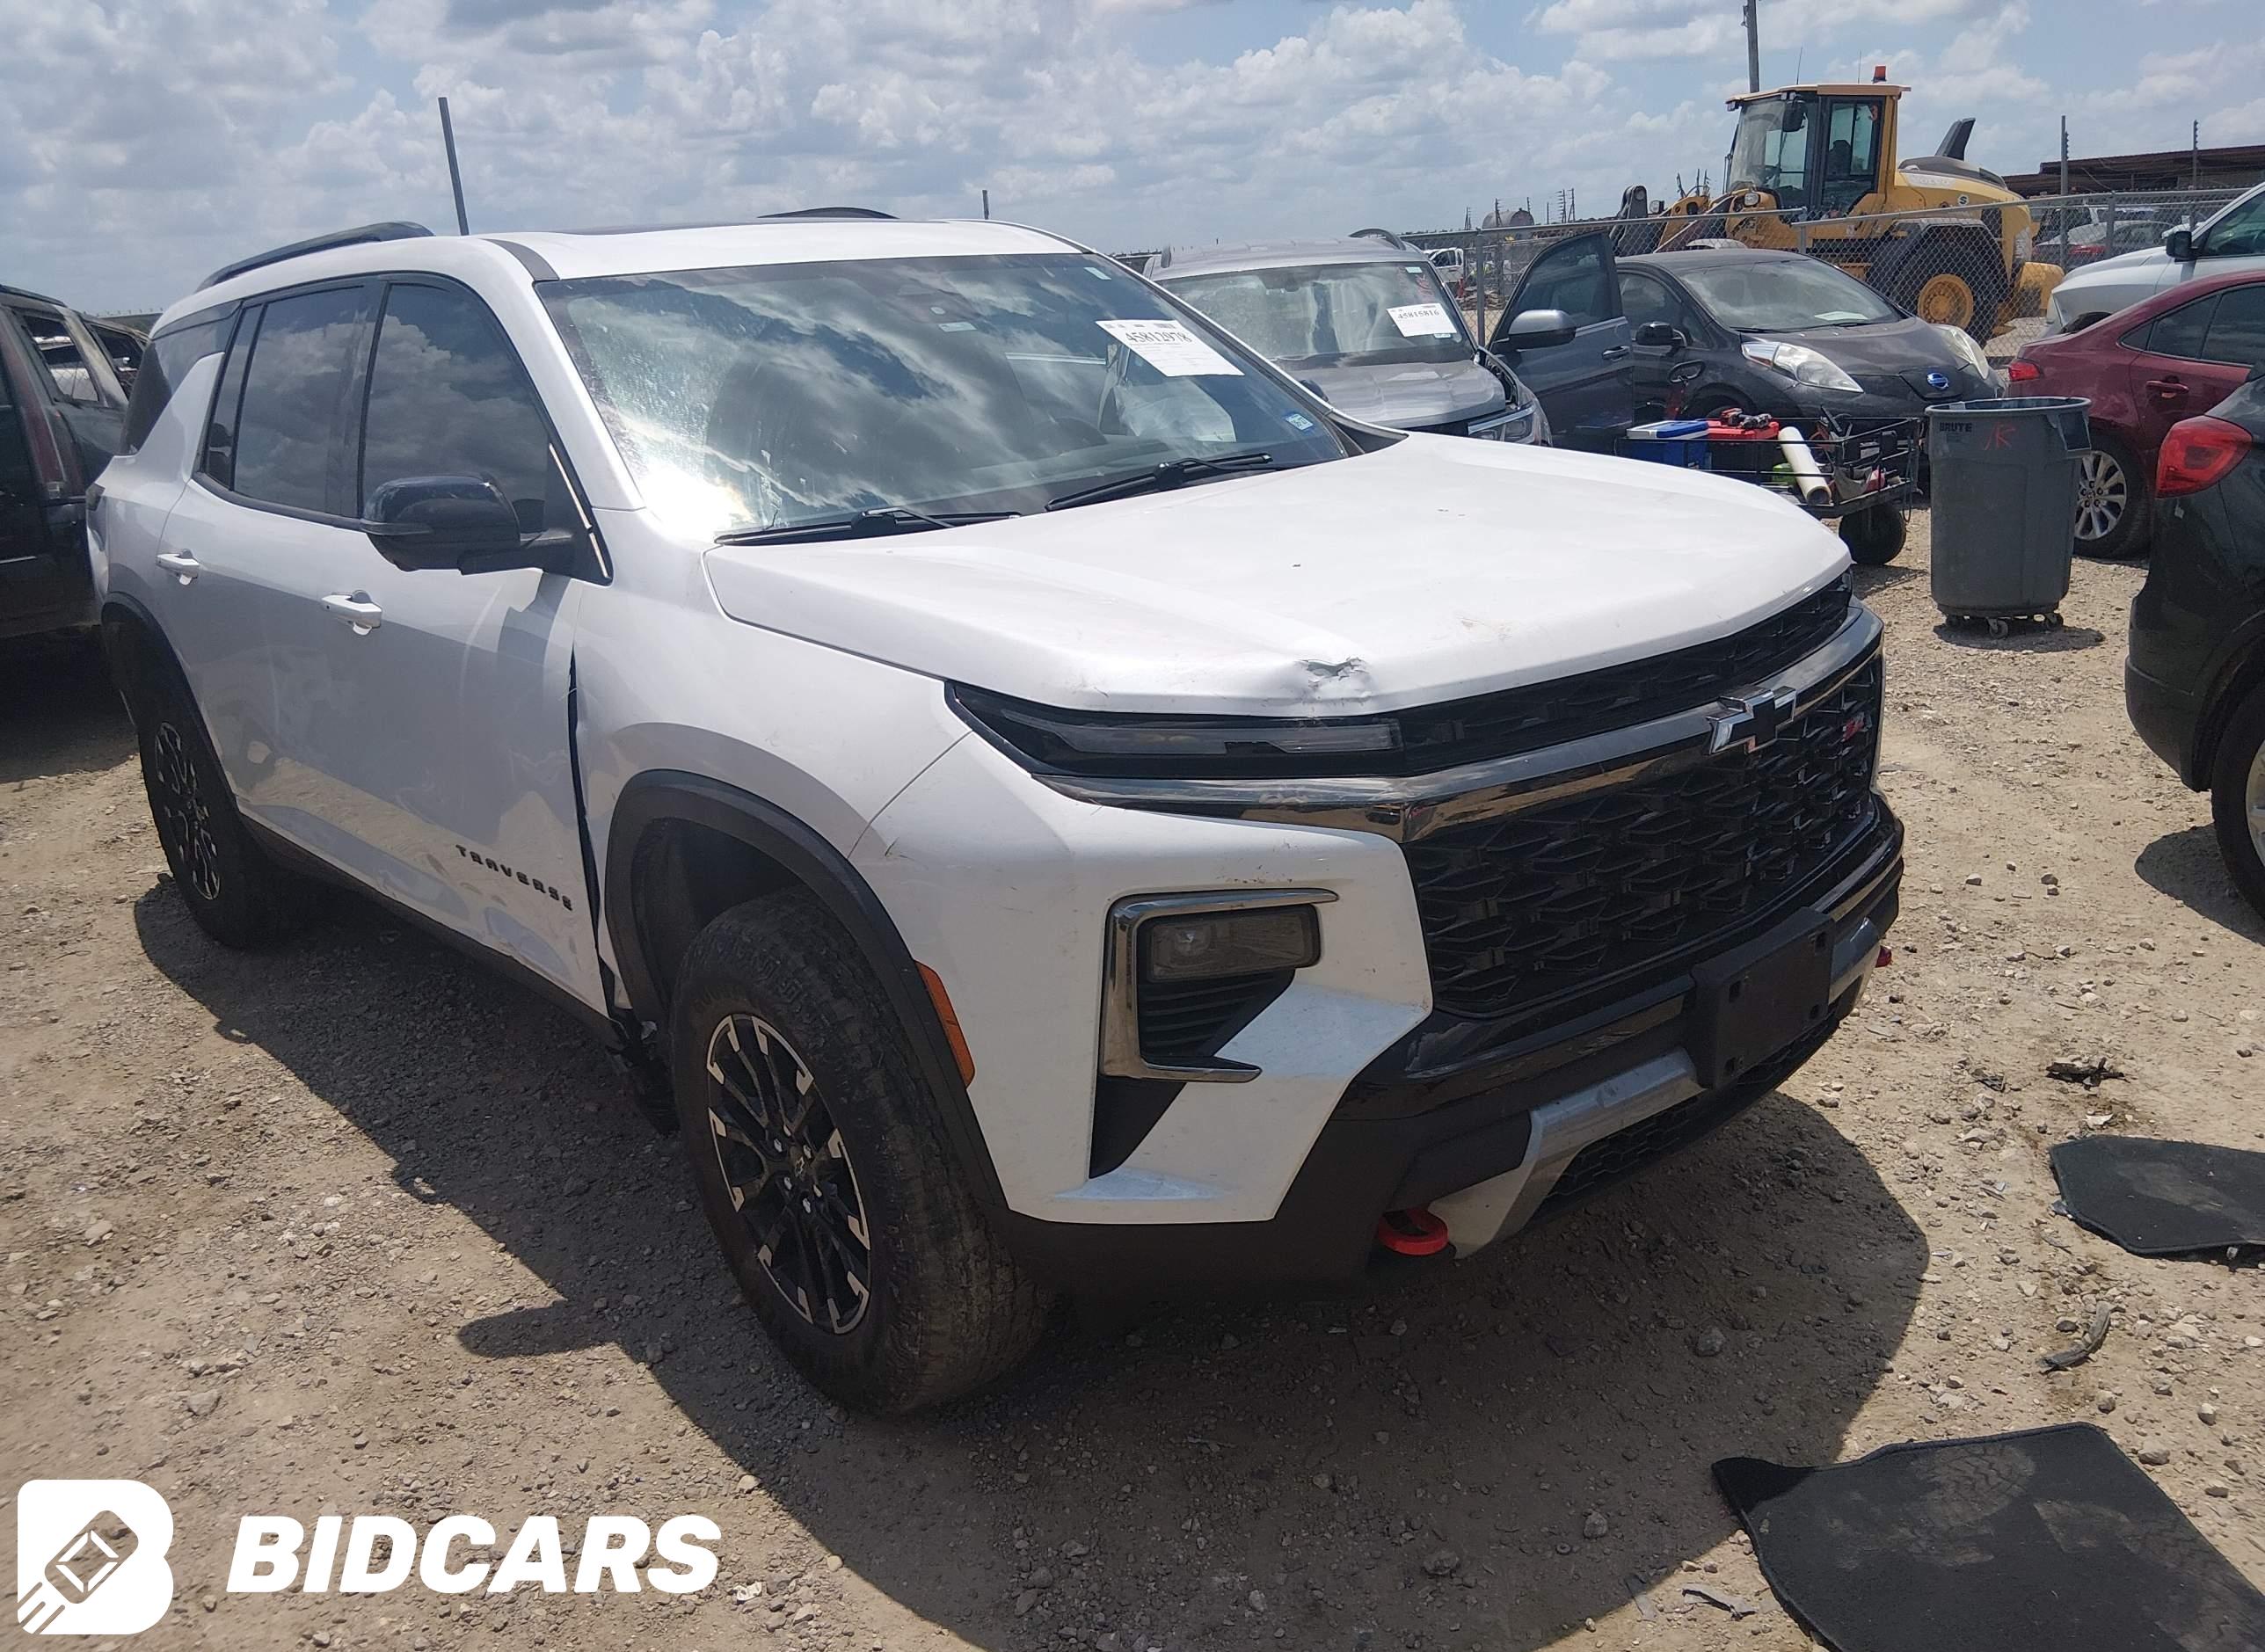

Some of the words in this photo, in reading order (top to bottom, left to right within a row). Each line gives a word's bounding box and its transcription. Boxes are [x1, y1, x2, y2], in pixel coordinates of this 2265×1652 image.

[1397, 309, 1440, 319] 45815816
[1125, 331, 1193, 344] 45812978
[1939, 422, 1972, 433] BRUTE
[455, 844, 572, 911] TRAVERSE
